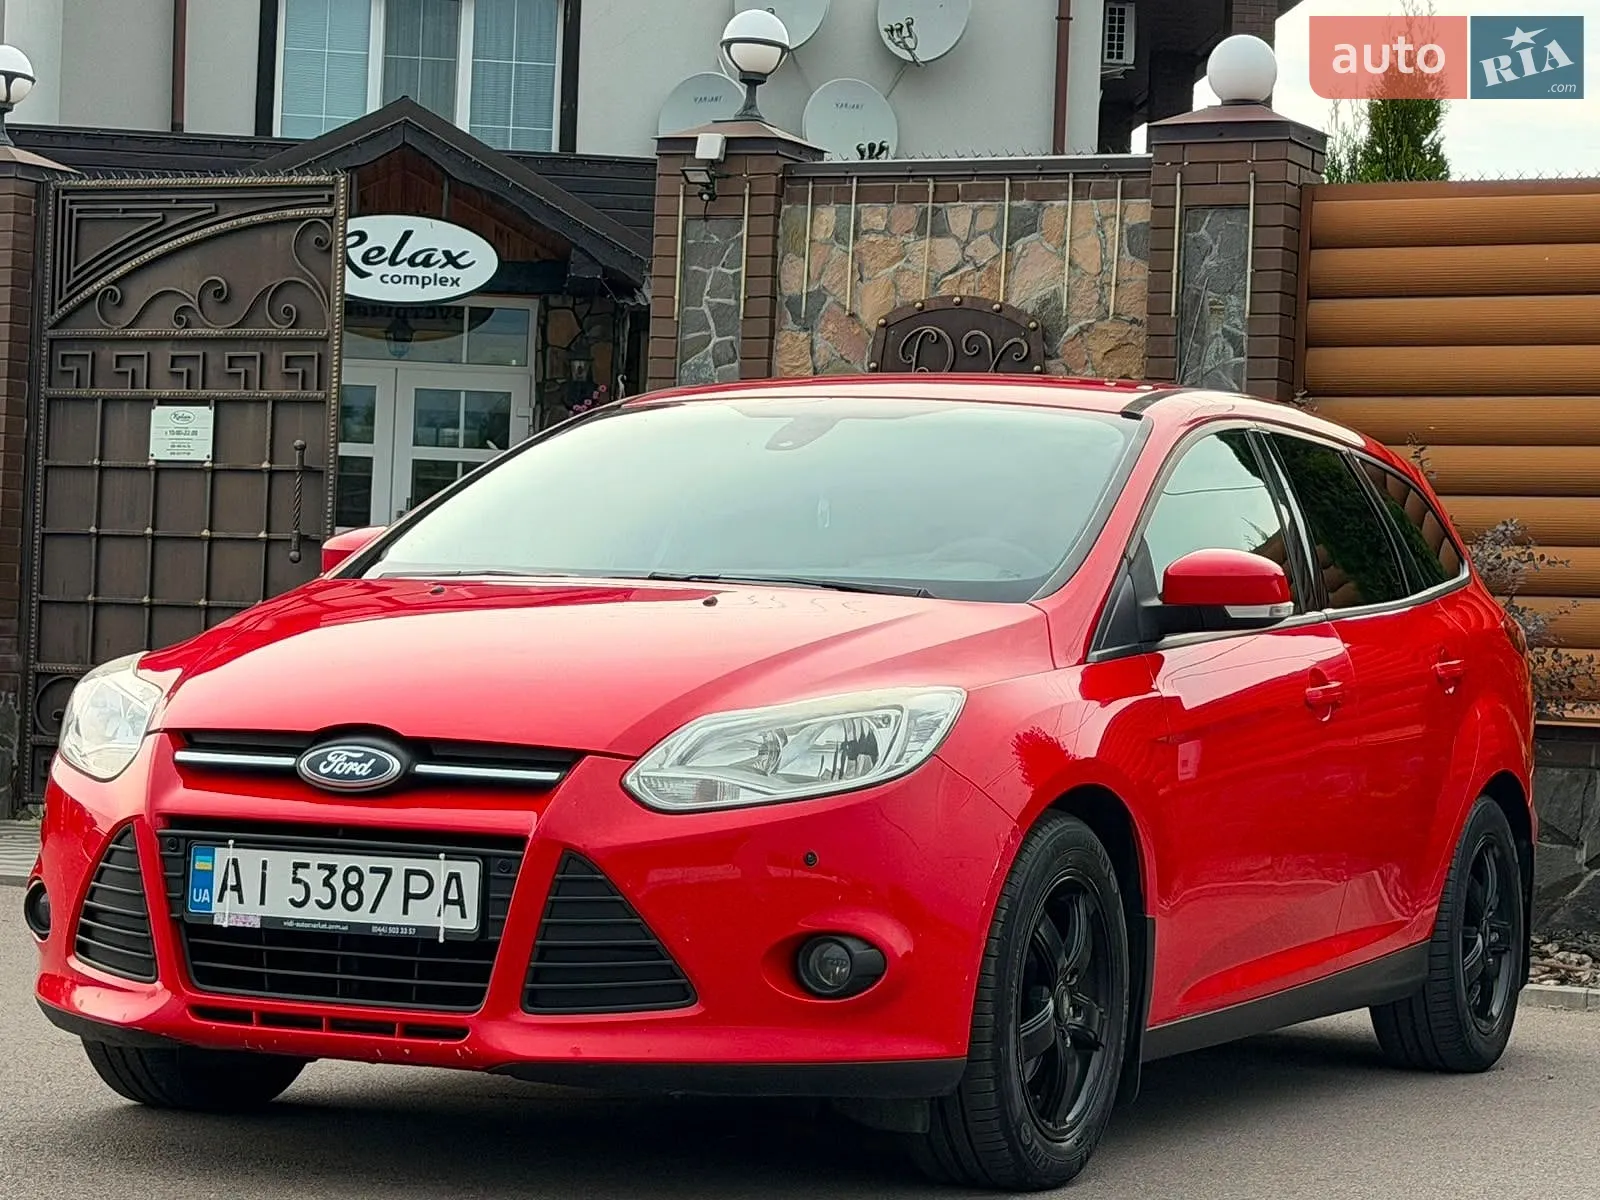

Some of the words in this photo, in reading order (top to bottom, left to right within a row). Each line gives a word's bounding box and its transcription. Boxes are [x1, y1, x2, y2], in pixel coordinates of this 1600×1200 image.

[345, 229, 477, 279] Relax
[380, 273, 461, 289] complex
[319, 750, 376, 777] Ford
[193, 887, 210, 903] UA
[217, 857, 268, 906] AI
[288, 861, 393, 914] 5387
[402, 868, 468, 919] PA
